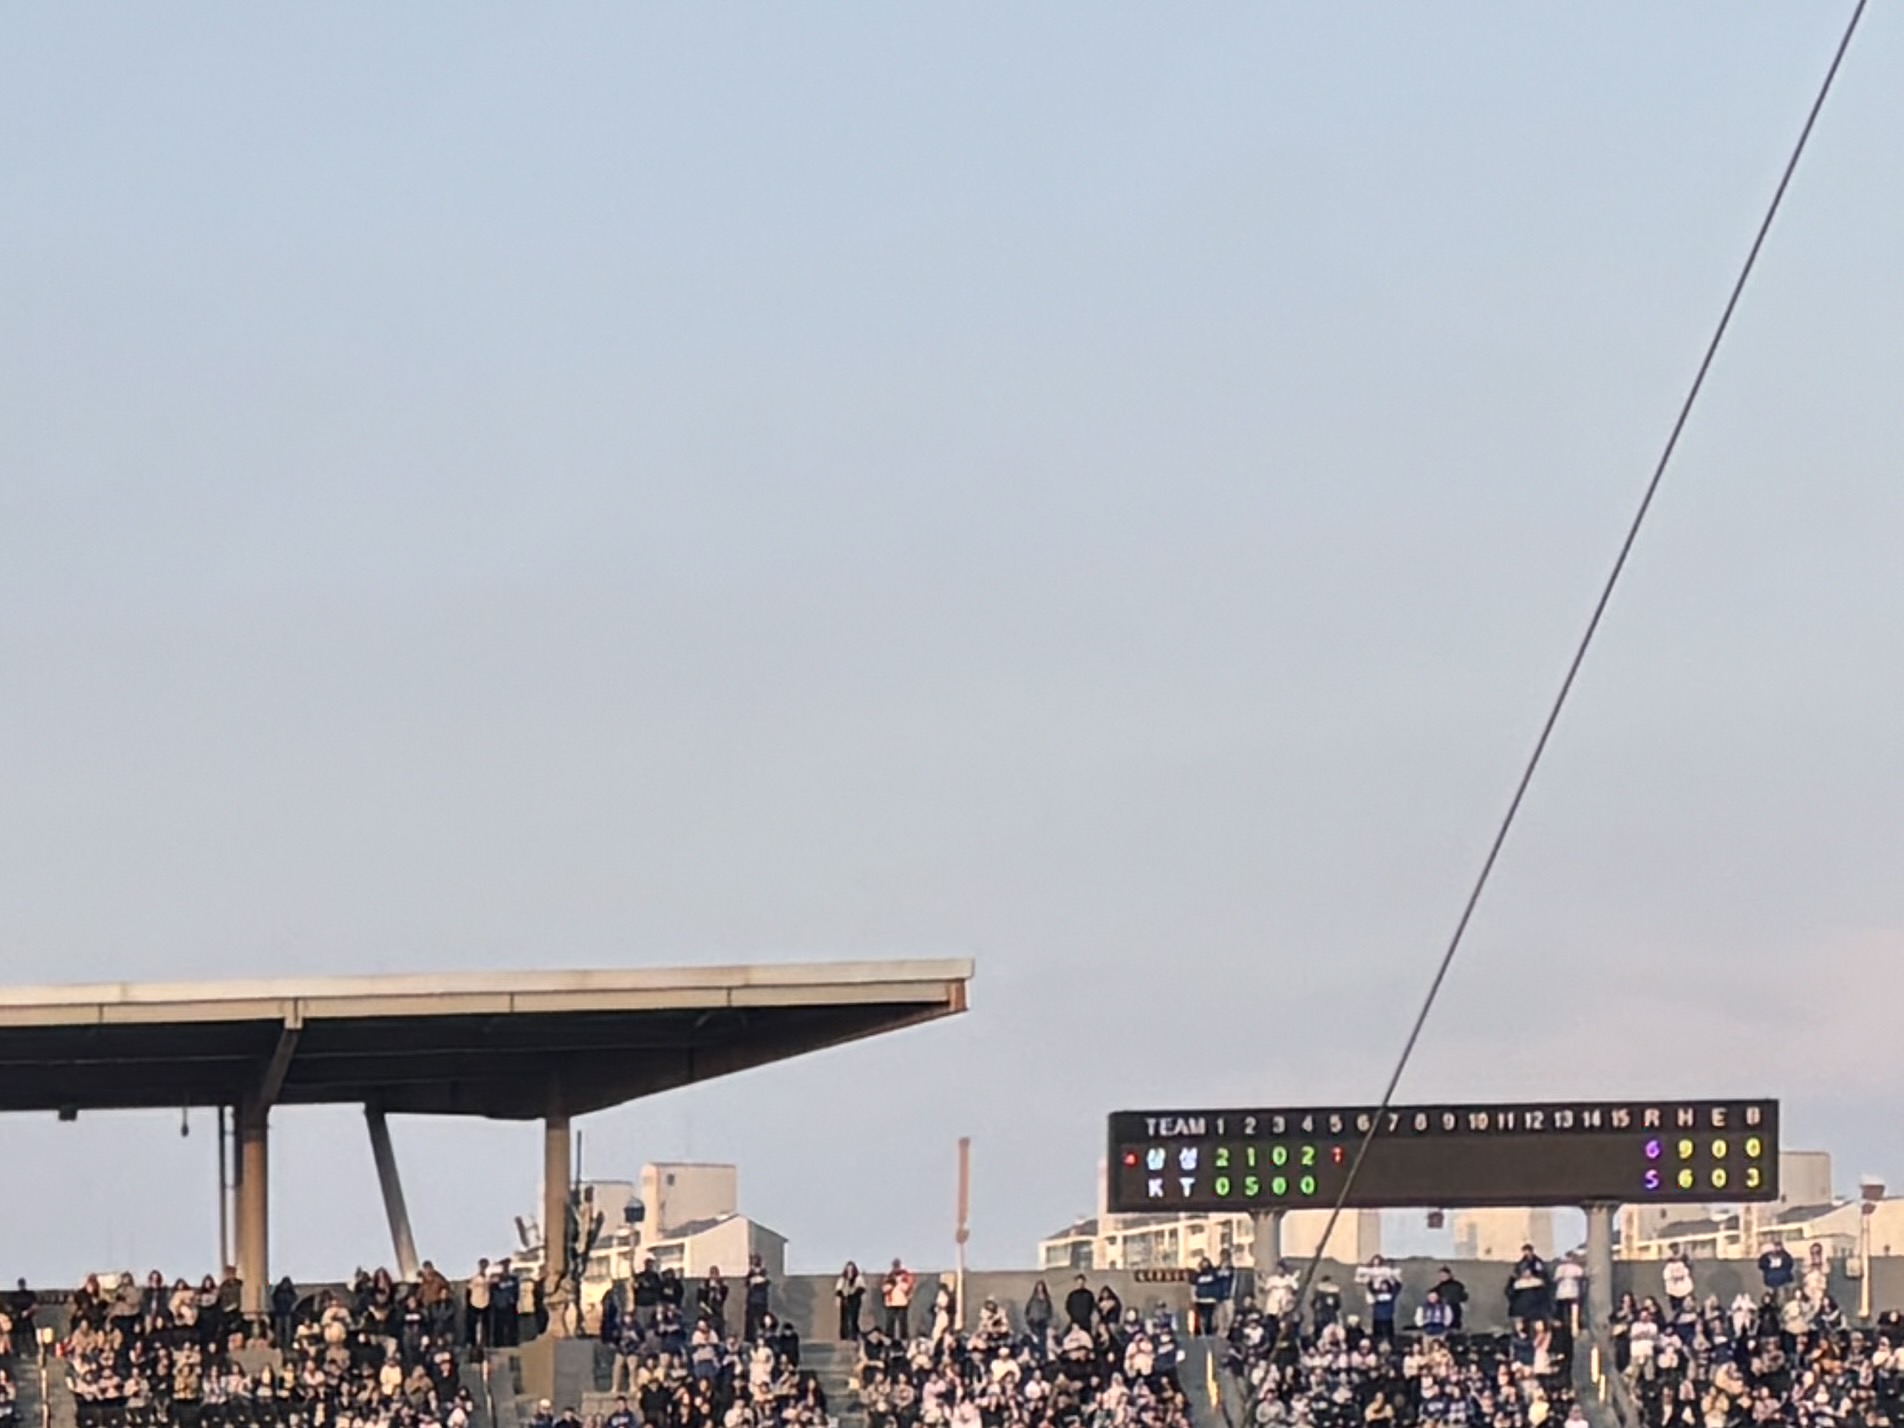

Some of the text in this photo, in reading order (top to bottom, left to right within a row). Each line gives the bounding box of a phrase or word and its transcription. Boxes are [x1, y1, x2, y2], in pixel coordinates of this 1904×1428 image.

[1145, 1117, 1206, 1136] TEAM
[1216, 1119, 1225, 1135] 1
[1243, 1118, 1256, 1135] 2
[1272, 1117, 1286, 1134] 3
[1301, 1116, 1314, 1133] 4
[1329, 1116, 1343, 1133] 5
[1356, 1115, 1370, 1132] 6
[1387, 1113, 1399, 1131] 7
[1414, 1113, 1428, 1130] 8
[1443, 1112, 1456, 1130] 9
[1468, 1112, 1489, 1130] 10
[1497, 1112, 1515, 1130] 11
[1524, 1111, 1544, 1130] 12
[1554, 1111, 1574, 1129] 13
[1582, 1110, 1602, 1128] 14
[1611, 1109, 1631, 1128] 15
[1644, 1109, 1661, 1127] R
[1677, 1108, 1693, 1127] H
[1711, 1108, 1727, 1126] E
[1215, 1147, 1228, 1167] 2
[1247, 1147, 1256, 1166] 1
[1272, 1146, 1286, 1166] 0
[1300, 1146, 1315, 1166] 2
[1645, 1140, 1660, 1159] 6
[1678, 1139, 1692, 1159] 9
[1711, 1139, 1726, 1158] 0
[1746, 1138, 1760, 1157] 0
[1147, 1178, 1163, 1197] K
[1178, 1178, 1196, 1197] T
[1215, 1176, 1230, 1196] 0
[1300, 1175, 1315, 1195] 0
[1711, 1168, 1727, 1188] 0
[1746, 1167, 1760, 1187] 3
